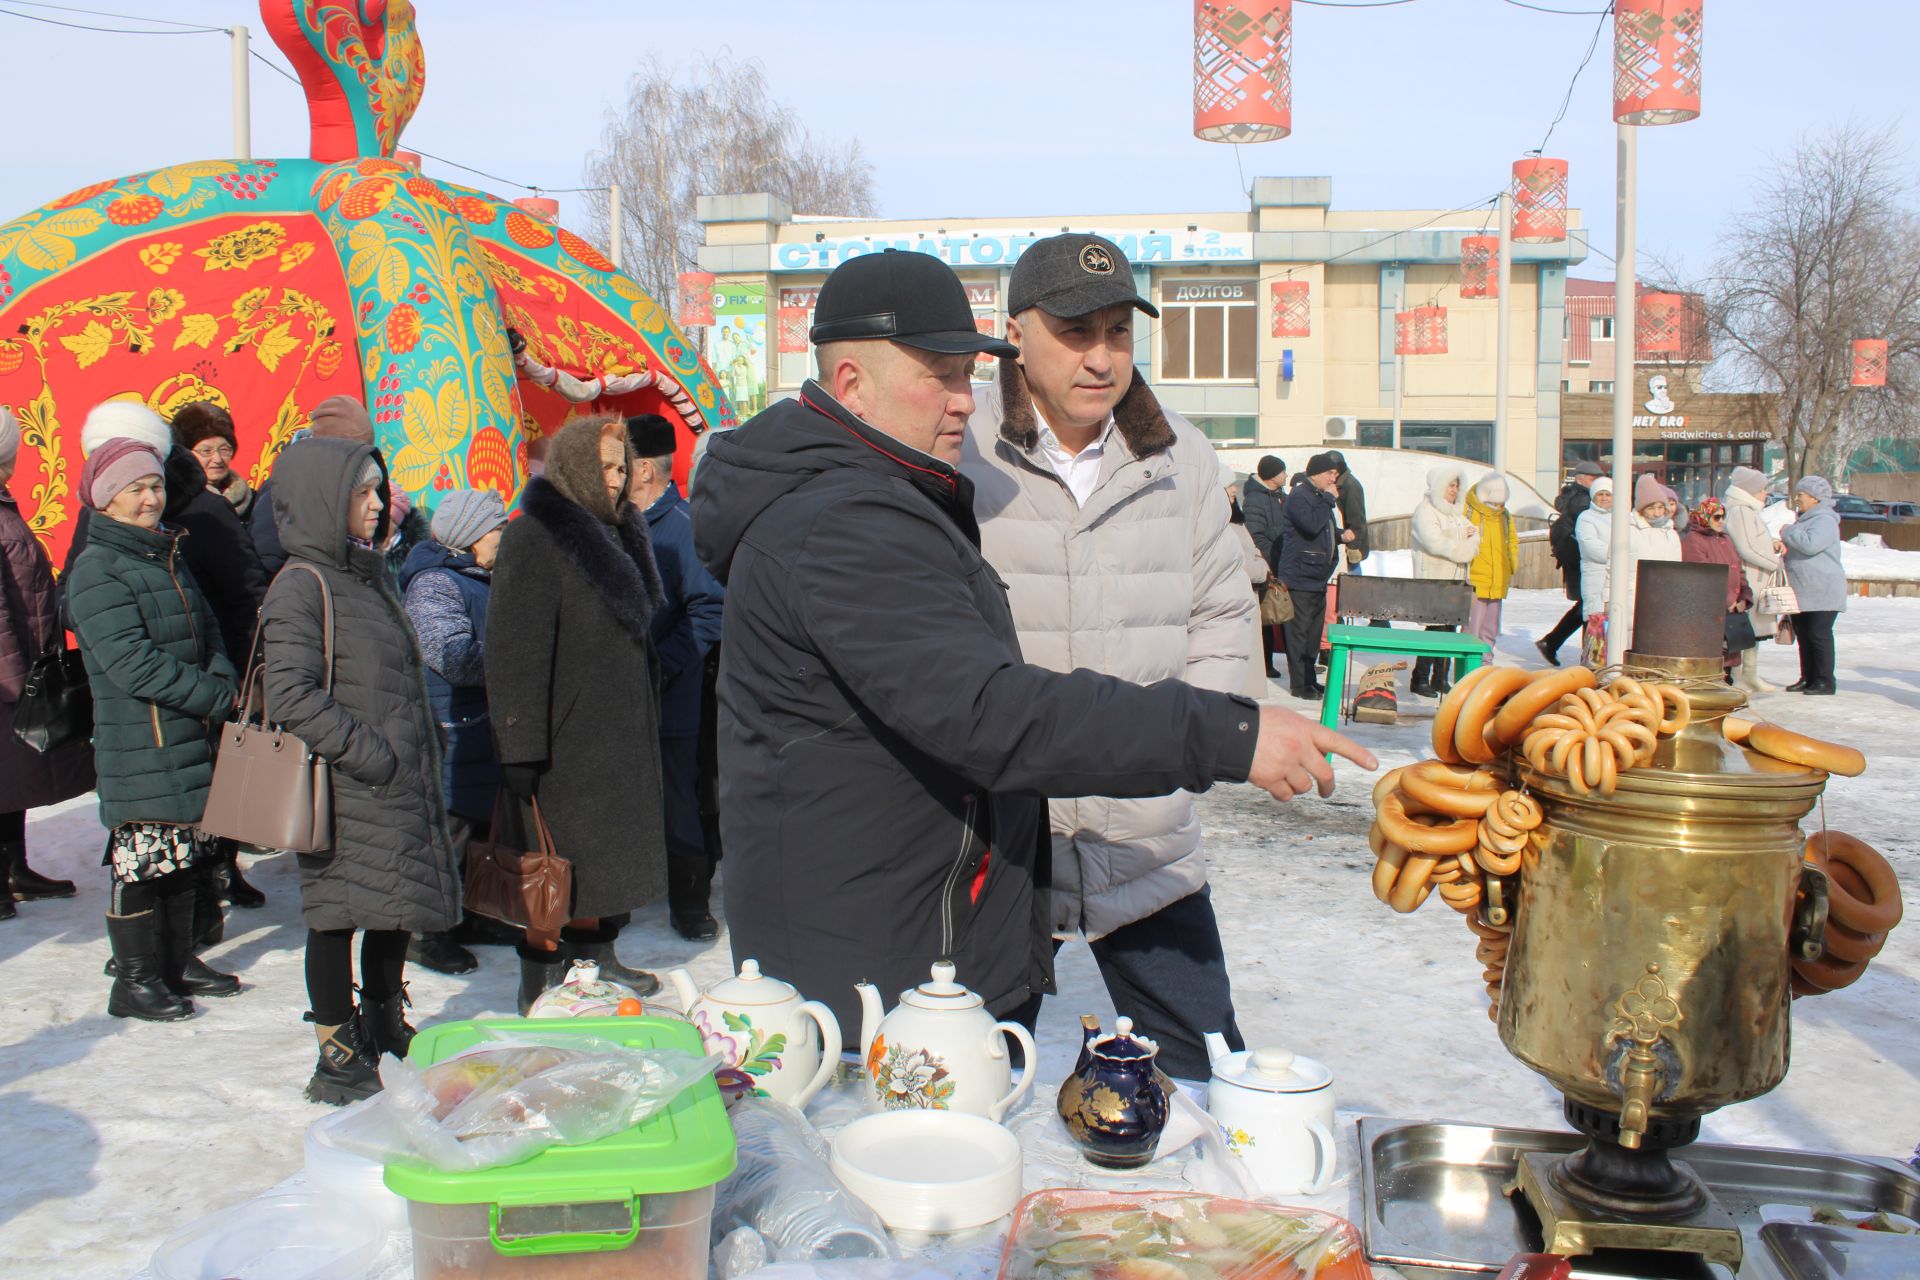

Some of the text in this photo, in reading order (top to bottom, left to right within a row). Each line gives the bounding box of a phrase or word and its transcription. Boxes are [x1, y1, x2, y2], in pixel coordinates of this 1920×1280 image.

[1204, 232, 1221, 244] 2
[778, 234, 1171, 268] СТОАТОЛИЯ
[1176, 285, 1243, 300] ДОЛГОВ
[1632, 415, 1657, 427] HEY
[1661, 430, 1772, 439] sandwiches & coffee
